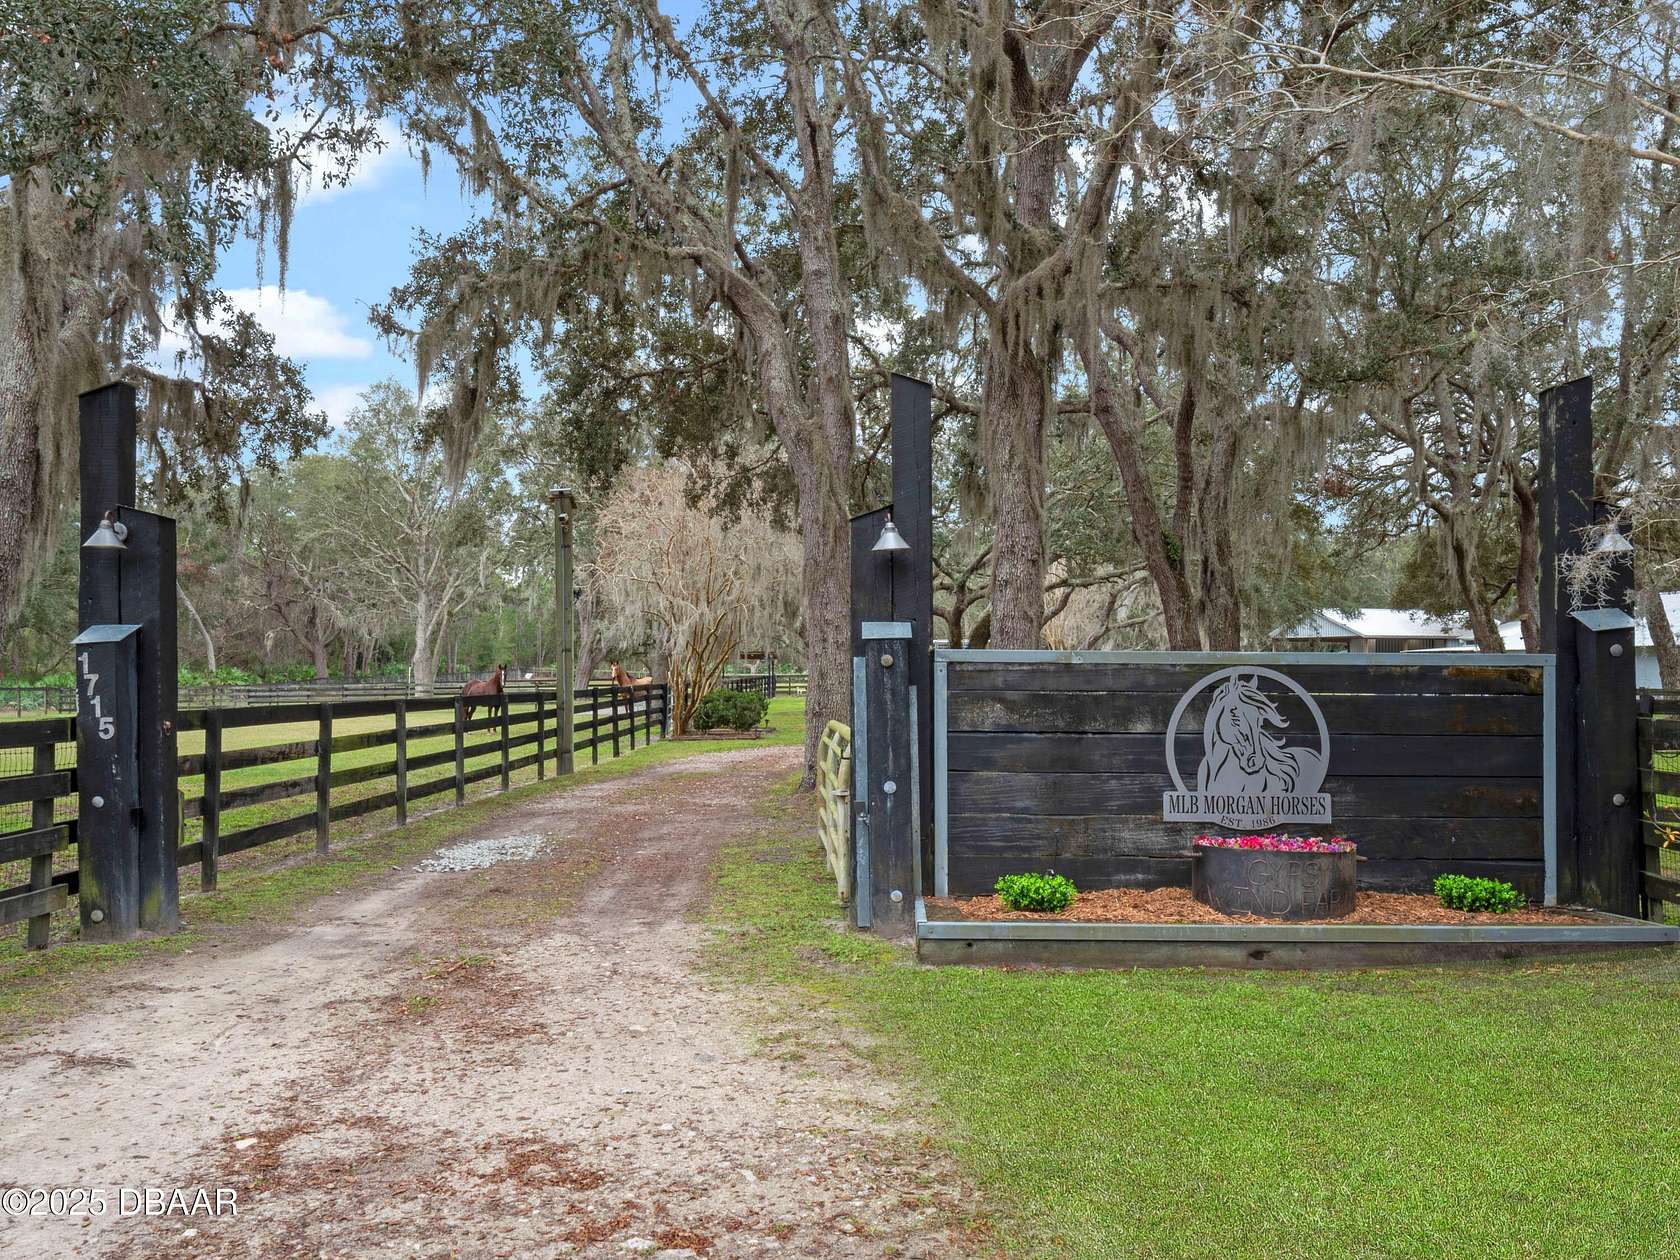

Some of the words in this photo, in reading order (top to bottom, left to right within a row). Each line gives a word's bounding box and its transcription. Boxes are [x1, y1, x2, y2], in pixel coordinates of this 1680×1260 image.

[78, 652, 115, 740] 1715
[1169, 794, 1199, 815] MLB
[1204, 795, 1266, 815] MORGAN
[1271, 796, 1326, 816] HORSES
[1251, 816, 1276, 829] 1986
